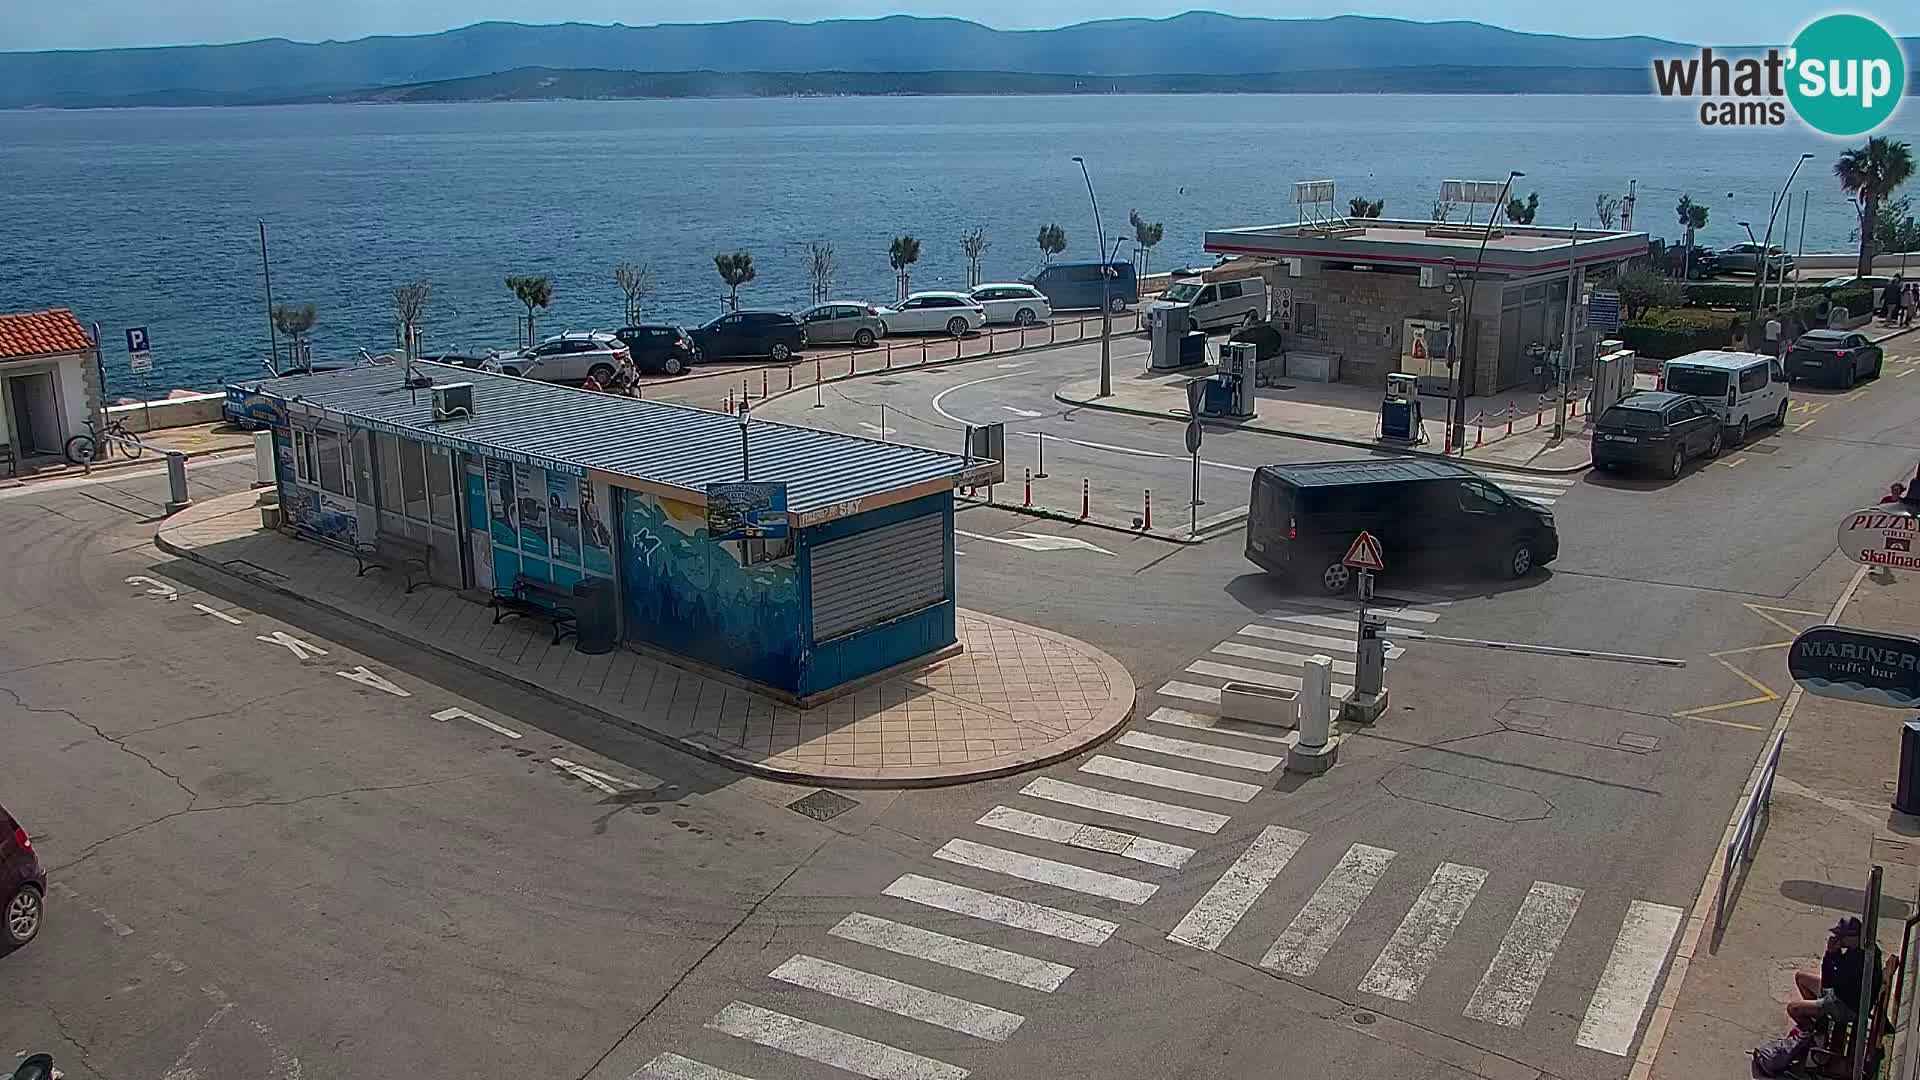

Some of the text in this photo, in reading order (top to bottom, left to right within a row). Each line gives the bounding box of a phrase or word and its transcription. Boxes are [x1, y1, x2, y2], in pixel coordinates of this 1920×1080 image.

[131, 330, 144, 349] P
[437, 434, 468, 450] POSTAJA
[494, 448, 527, 465] STATION
[529, 456, 555, 471] TICKET
[556, 462, 583, 477] OFFICE
[1848, 514, 1920, 532] PIZZE
[1828, 660, 1897, 679] caffe bar
